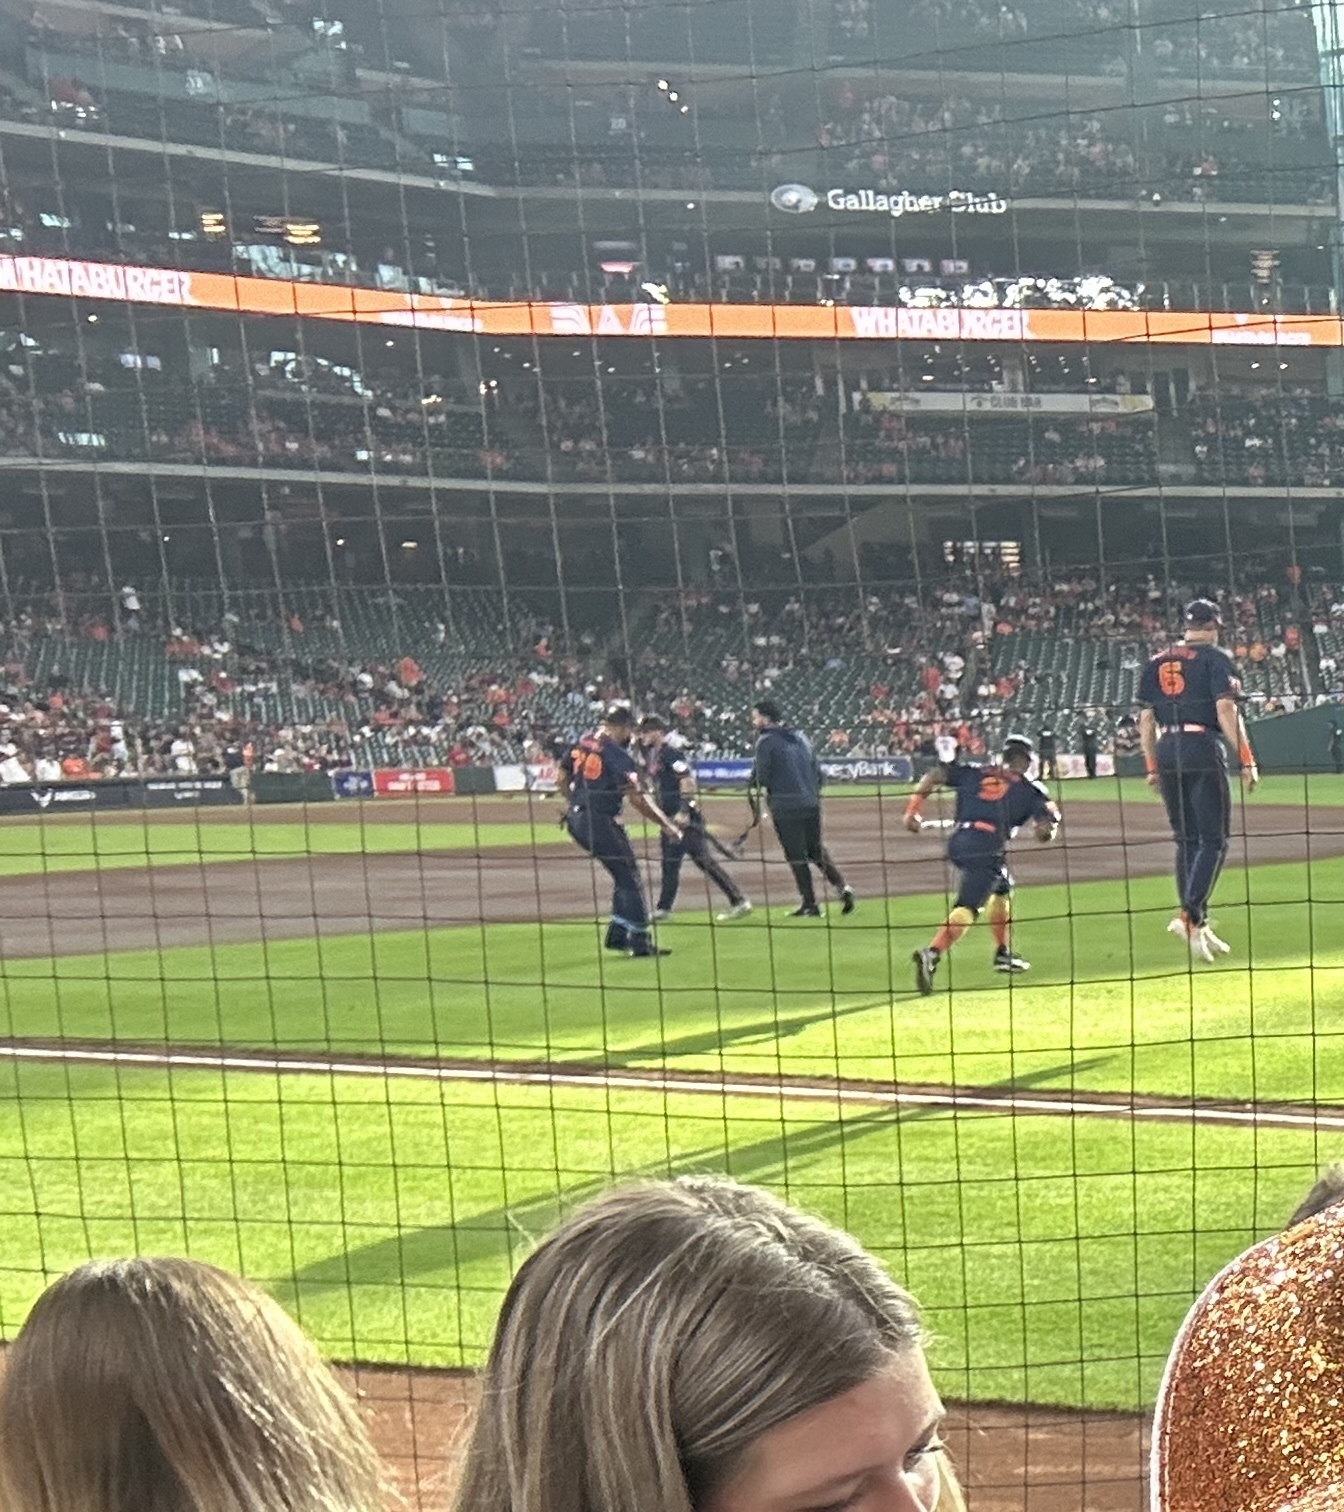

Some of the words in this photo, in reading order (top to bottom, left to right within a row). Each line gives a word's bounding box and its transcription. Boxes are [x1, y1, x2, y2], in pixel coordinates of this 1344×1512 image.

[827, 189, 943, 217] Gallagher
[948, 189, 1007, 214] Club
[850, 309, 1030, 338] WHATABURGER
[1159, 661, 1185, 695] 6
